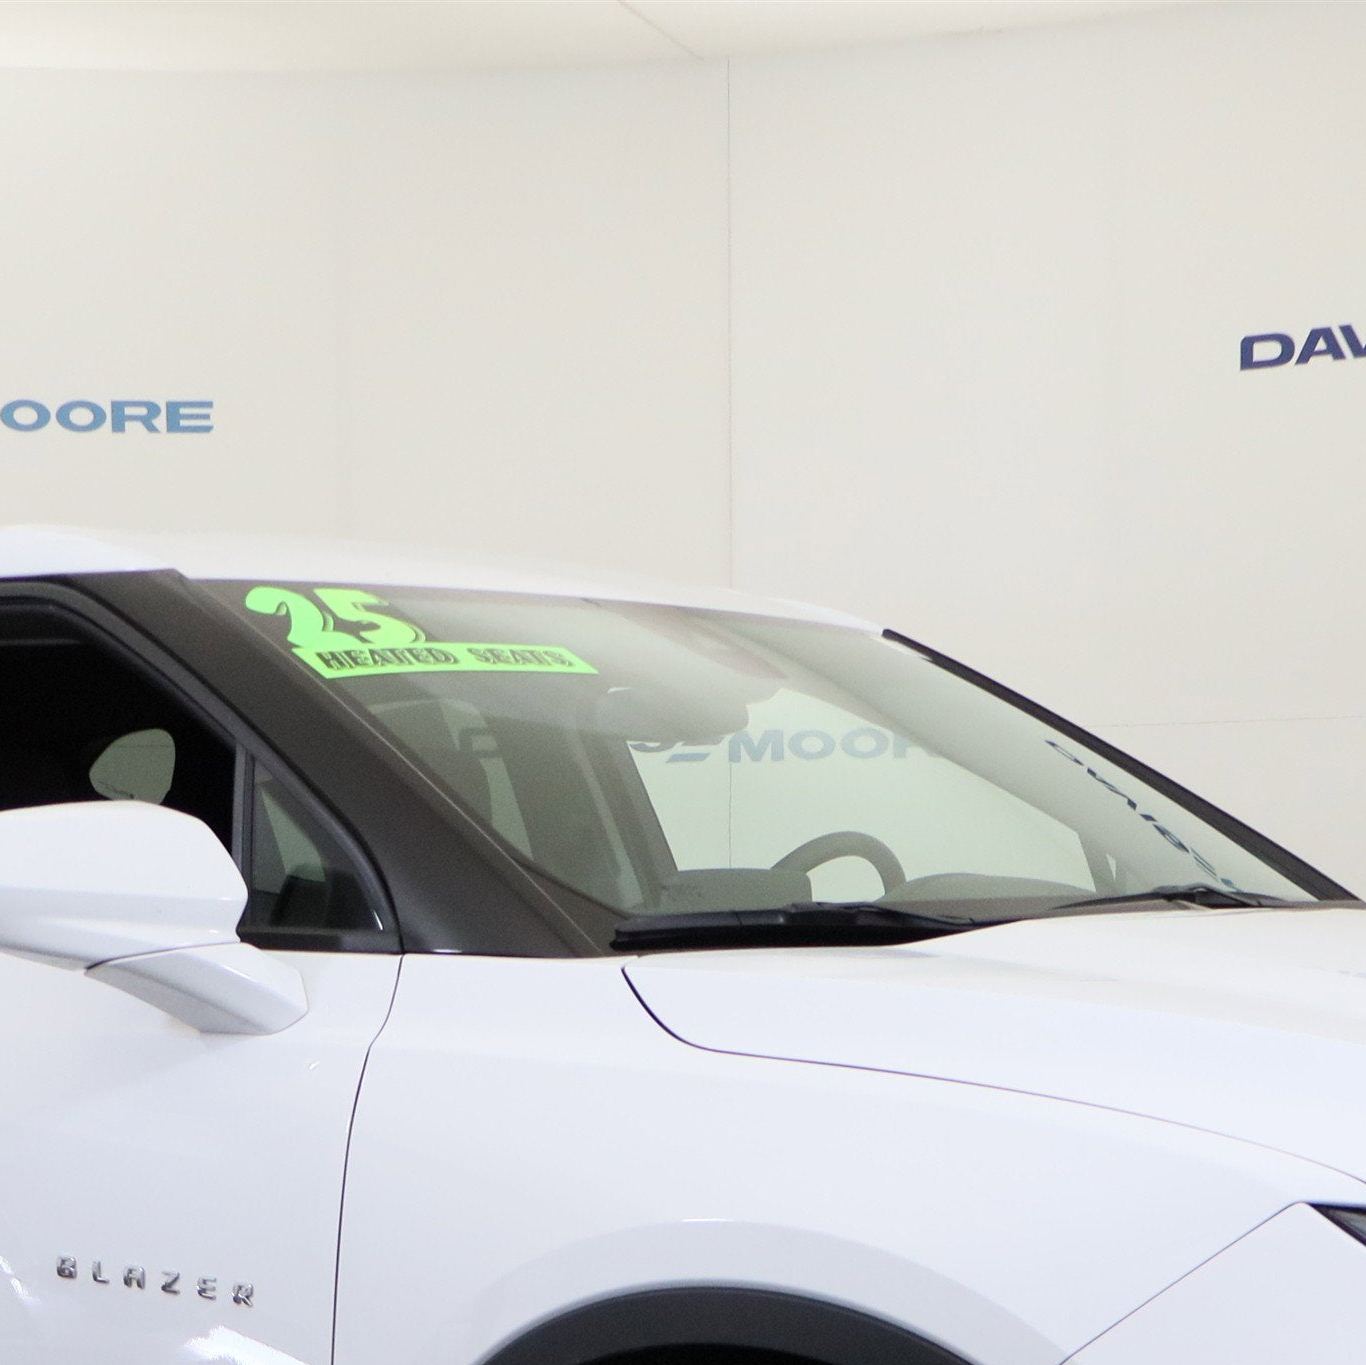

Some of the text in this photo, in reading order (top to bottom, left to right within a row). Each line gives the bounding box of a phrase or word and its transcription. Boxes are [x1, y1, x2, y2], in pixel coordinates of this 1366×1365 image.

[245, 586, 426, 648] 25
[315, 648, 576, 670] HEATED SEATS
[56, 1254, 254, 1308] BLAZER
